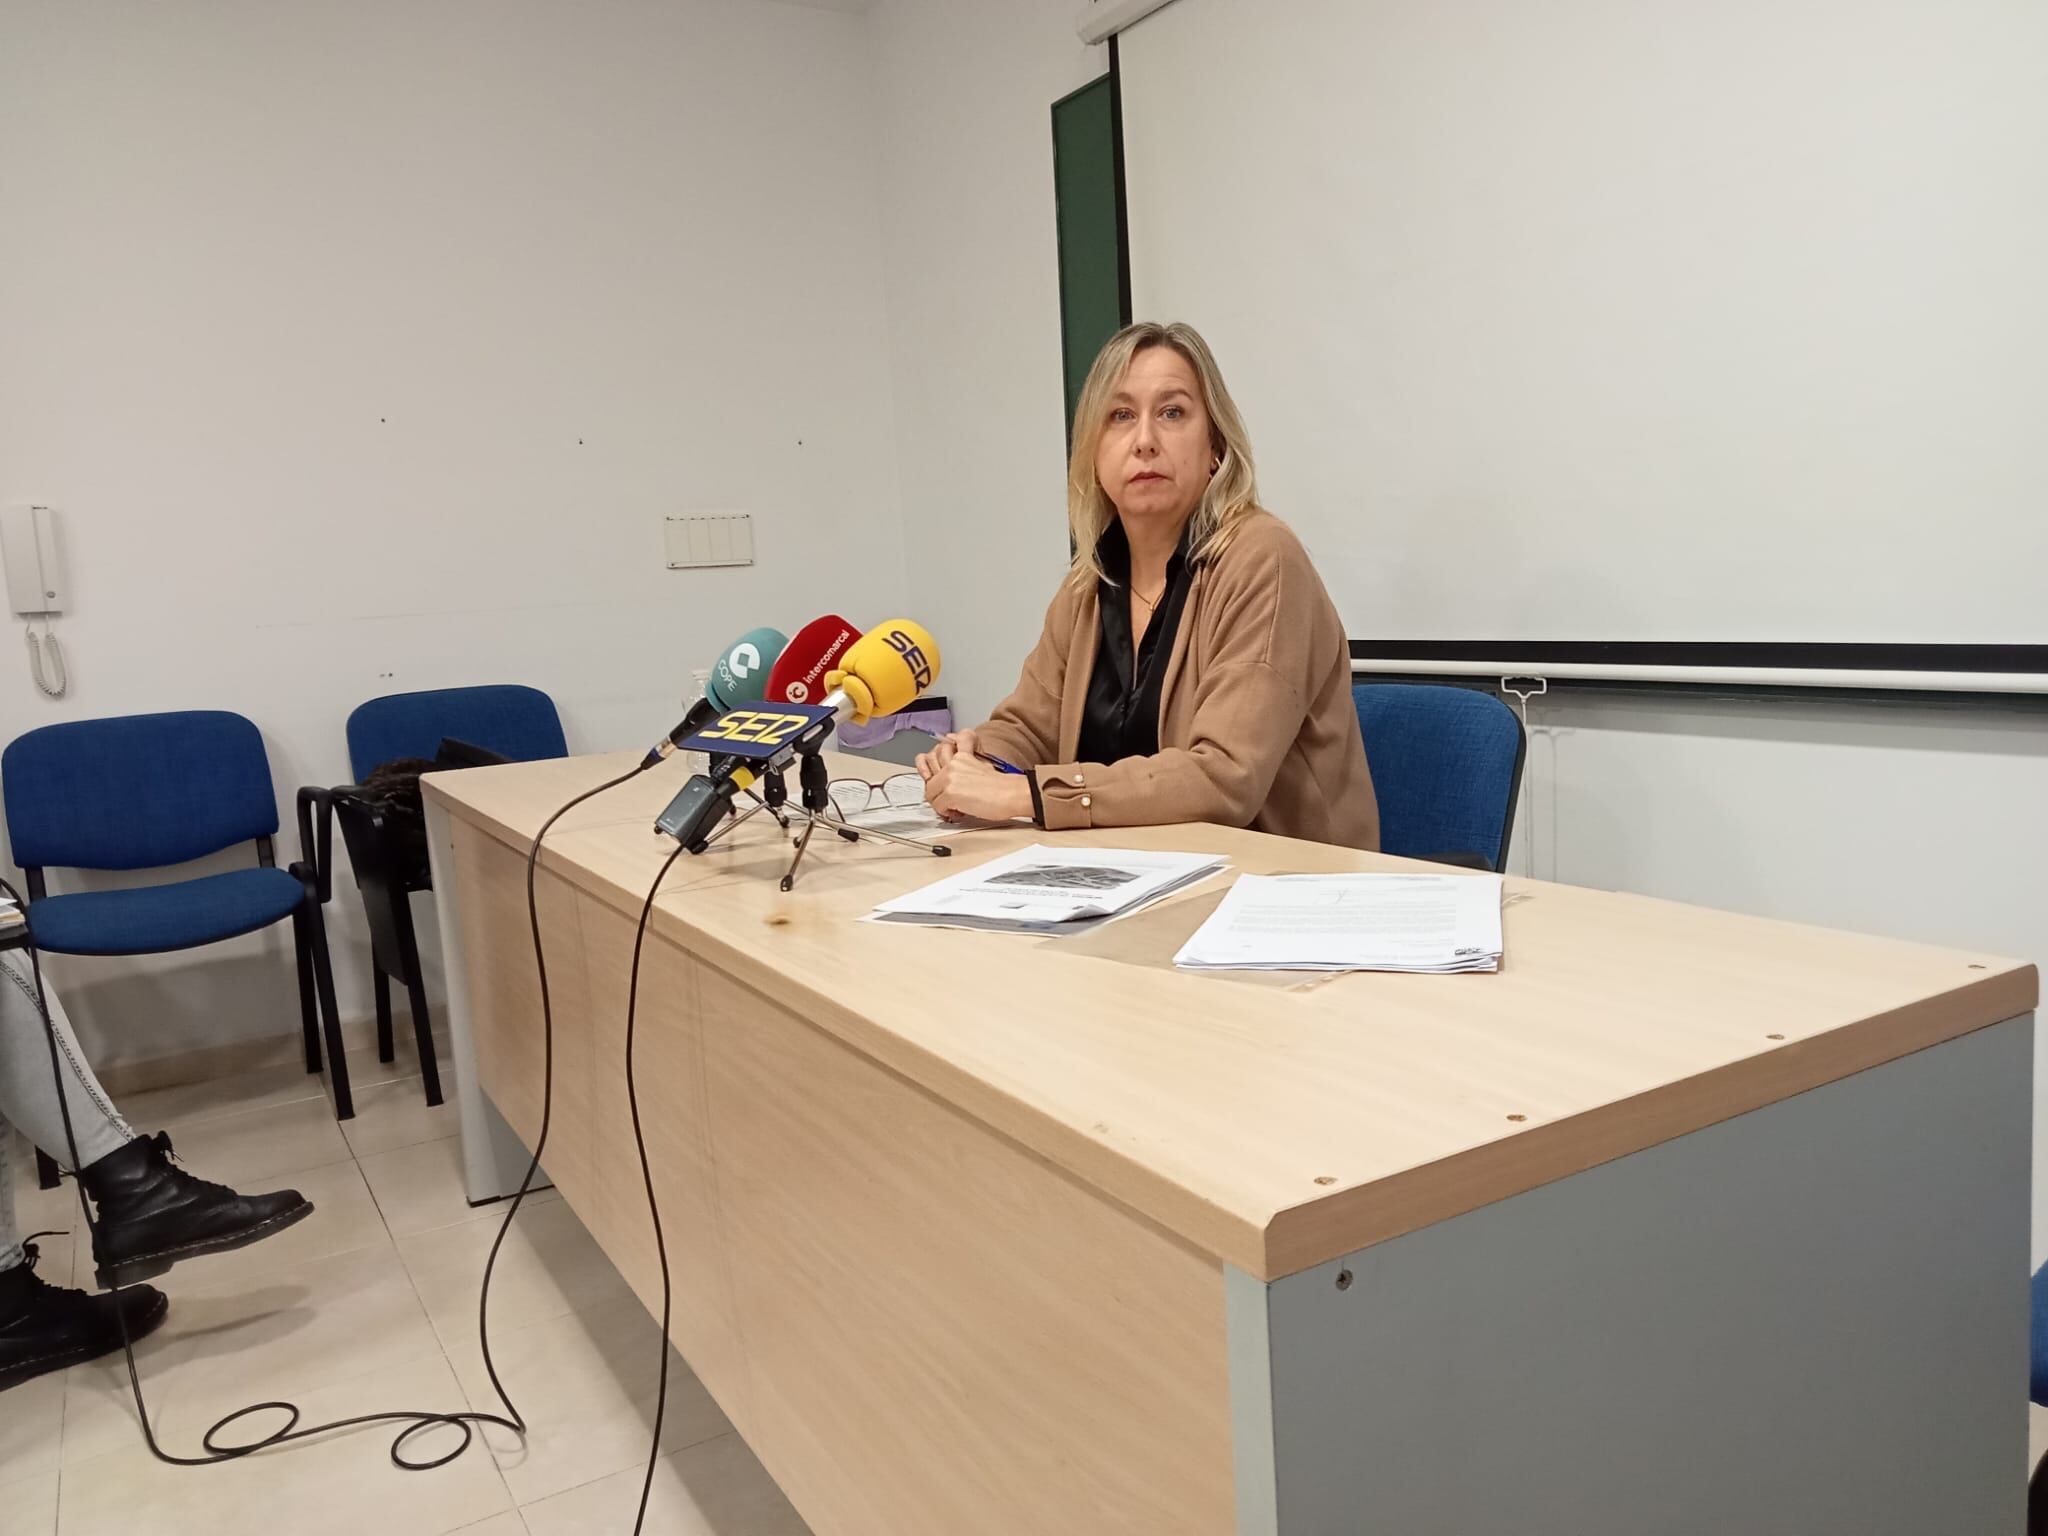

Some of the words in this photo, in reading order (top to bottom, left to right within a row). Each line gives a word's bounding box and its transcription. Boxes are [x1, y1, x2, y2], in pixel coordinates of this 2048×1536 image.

[718, 659, 738, 693] COPE
[882, 630, 932, 694] SER
[698, 711, 809, 745] SER
